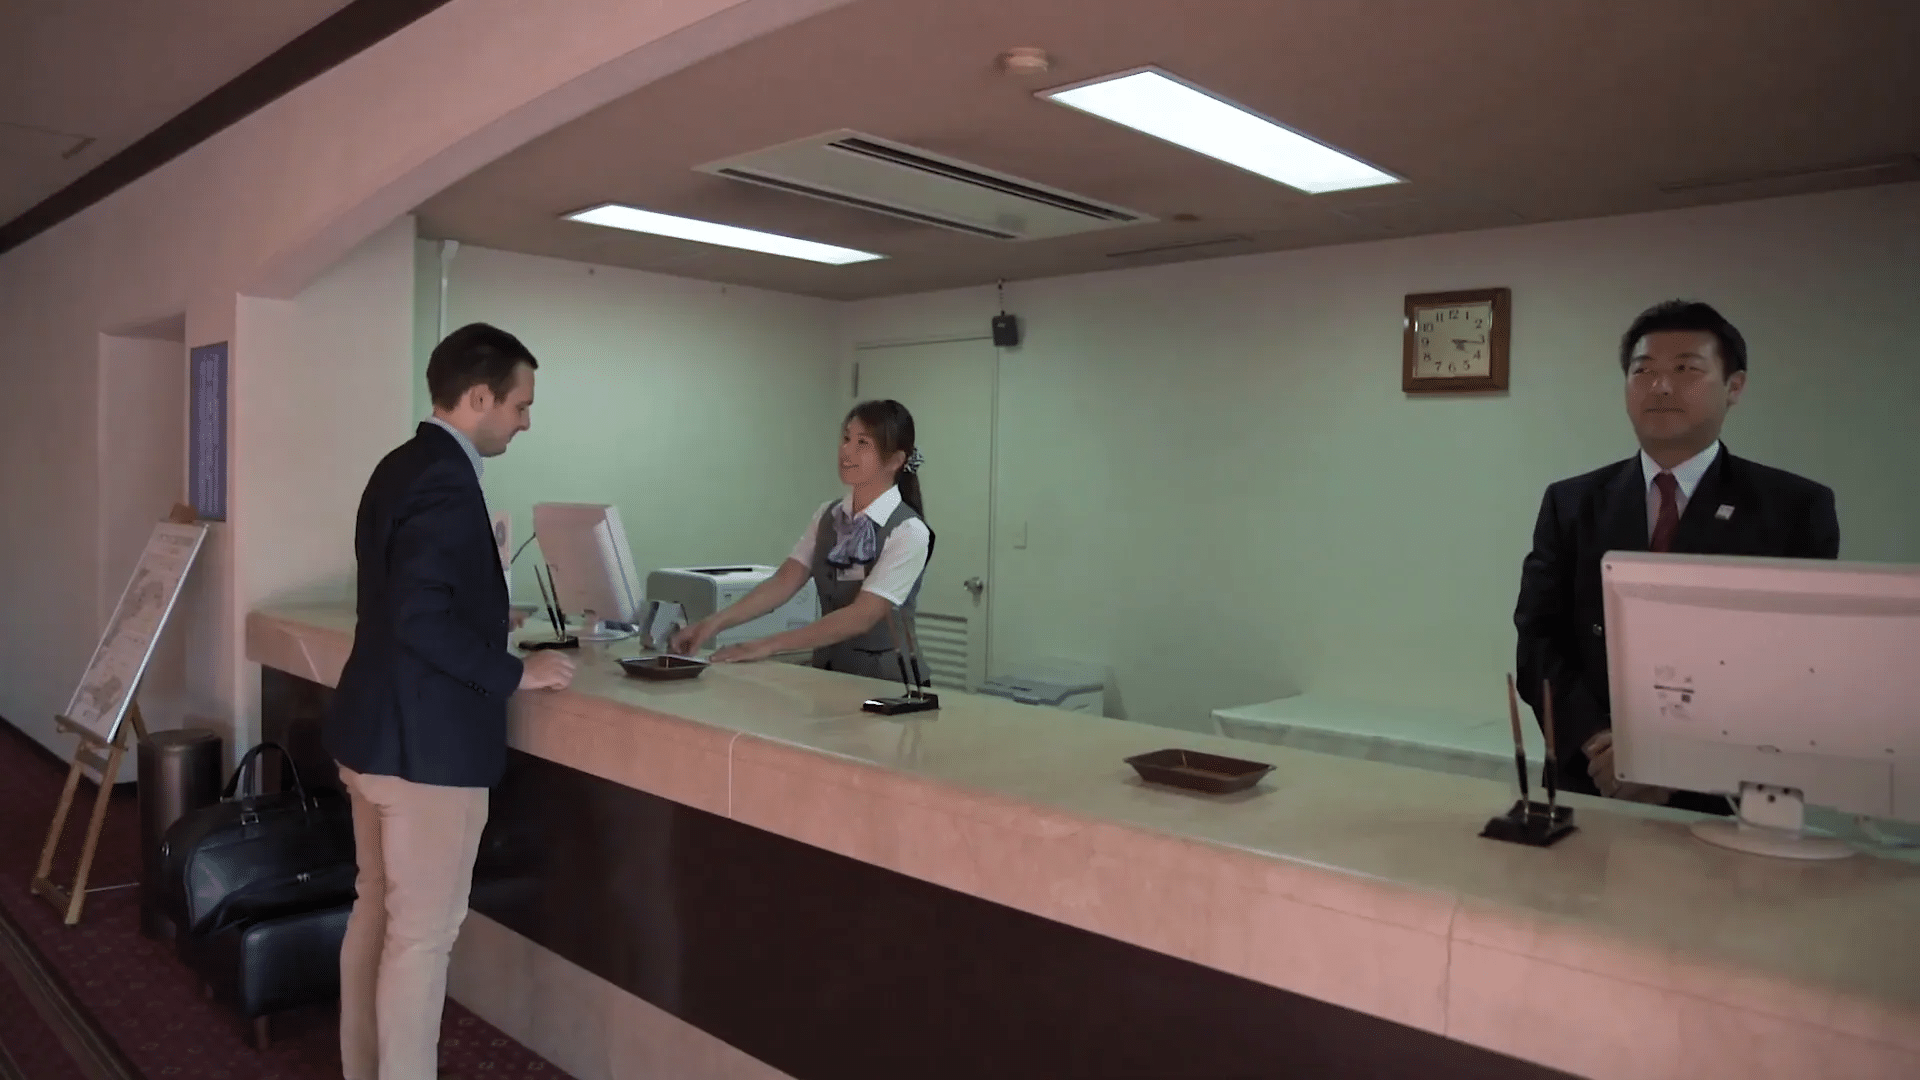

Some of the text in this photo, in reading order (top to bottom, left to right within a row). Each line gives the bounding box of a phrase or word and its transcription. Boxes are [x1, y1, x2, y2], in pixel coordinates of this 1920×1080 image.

[1436, 312, 1444, 322] 11
[1448, 309, 1459, 320] 12
[1465, 311, 1470, 320] 1
[1422, 323, 1434, 333] 10
[1475, 318, 1483, 329] 2
[1421, 337, 1430, 348] 9
[1435, 361, 1442, 372] 7
